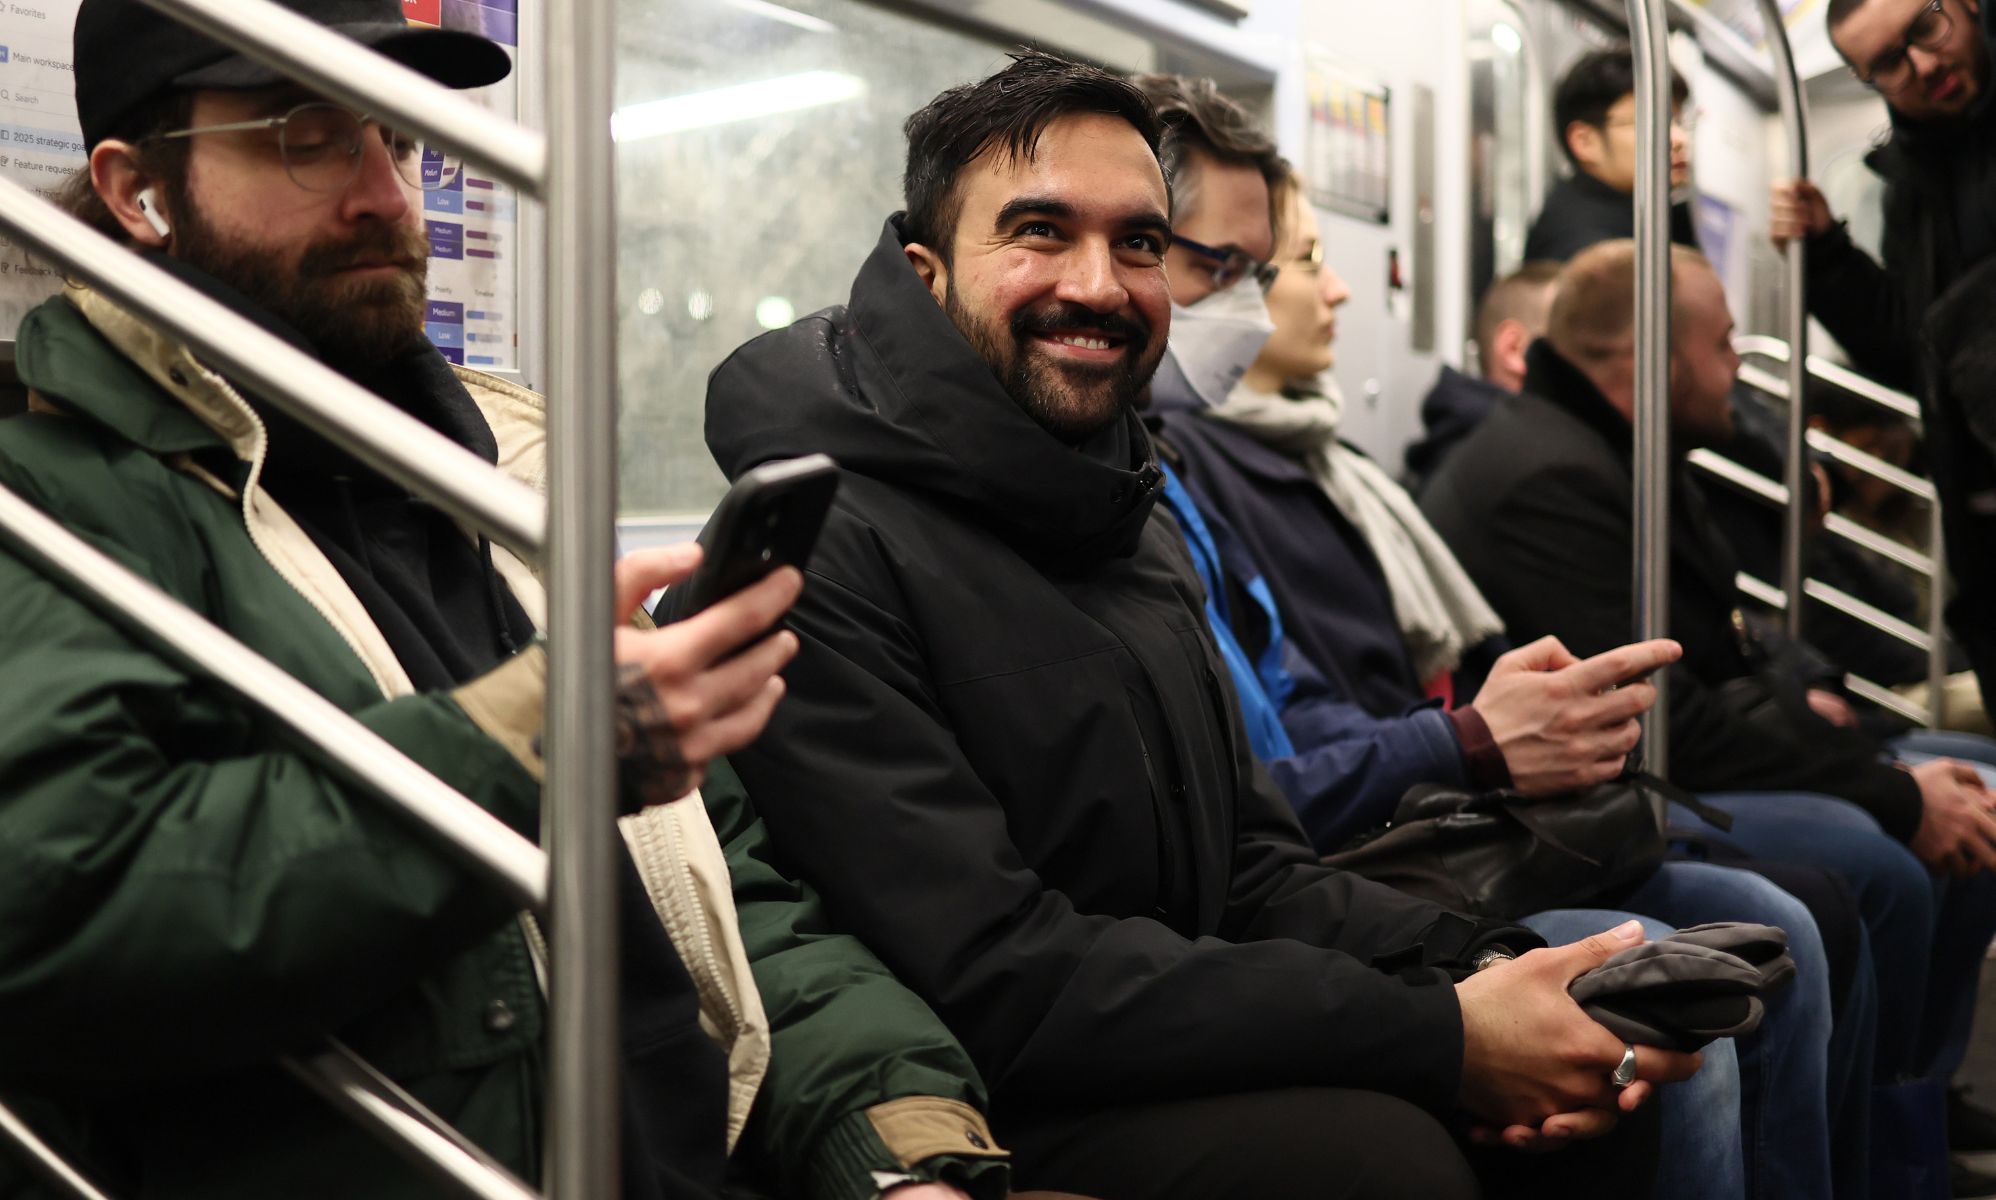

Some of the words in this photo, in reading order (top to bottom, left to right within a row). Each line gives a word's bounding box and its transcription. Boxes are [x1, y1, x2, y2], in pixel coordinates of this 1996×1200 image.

[10, 4, 46, 19] Favorites
[12, 52, 32, 63] Main
[15, 93, 39, 104] Search
[13, 132, 34, 144] 2025
[36, 136, 70, 150] strategic
[71, 142, 86, 152] goa
[14, 158, 44, 171] Feature
[45, 165, 77, 175] request
[437, 196, 449, 206] Low
[435, 227, 452, 235] Medium
[435, 245, 452, 253] Medium
[432, 307, 456, 317] Medium
[438, 331, 451, 340] Low
